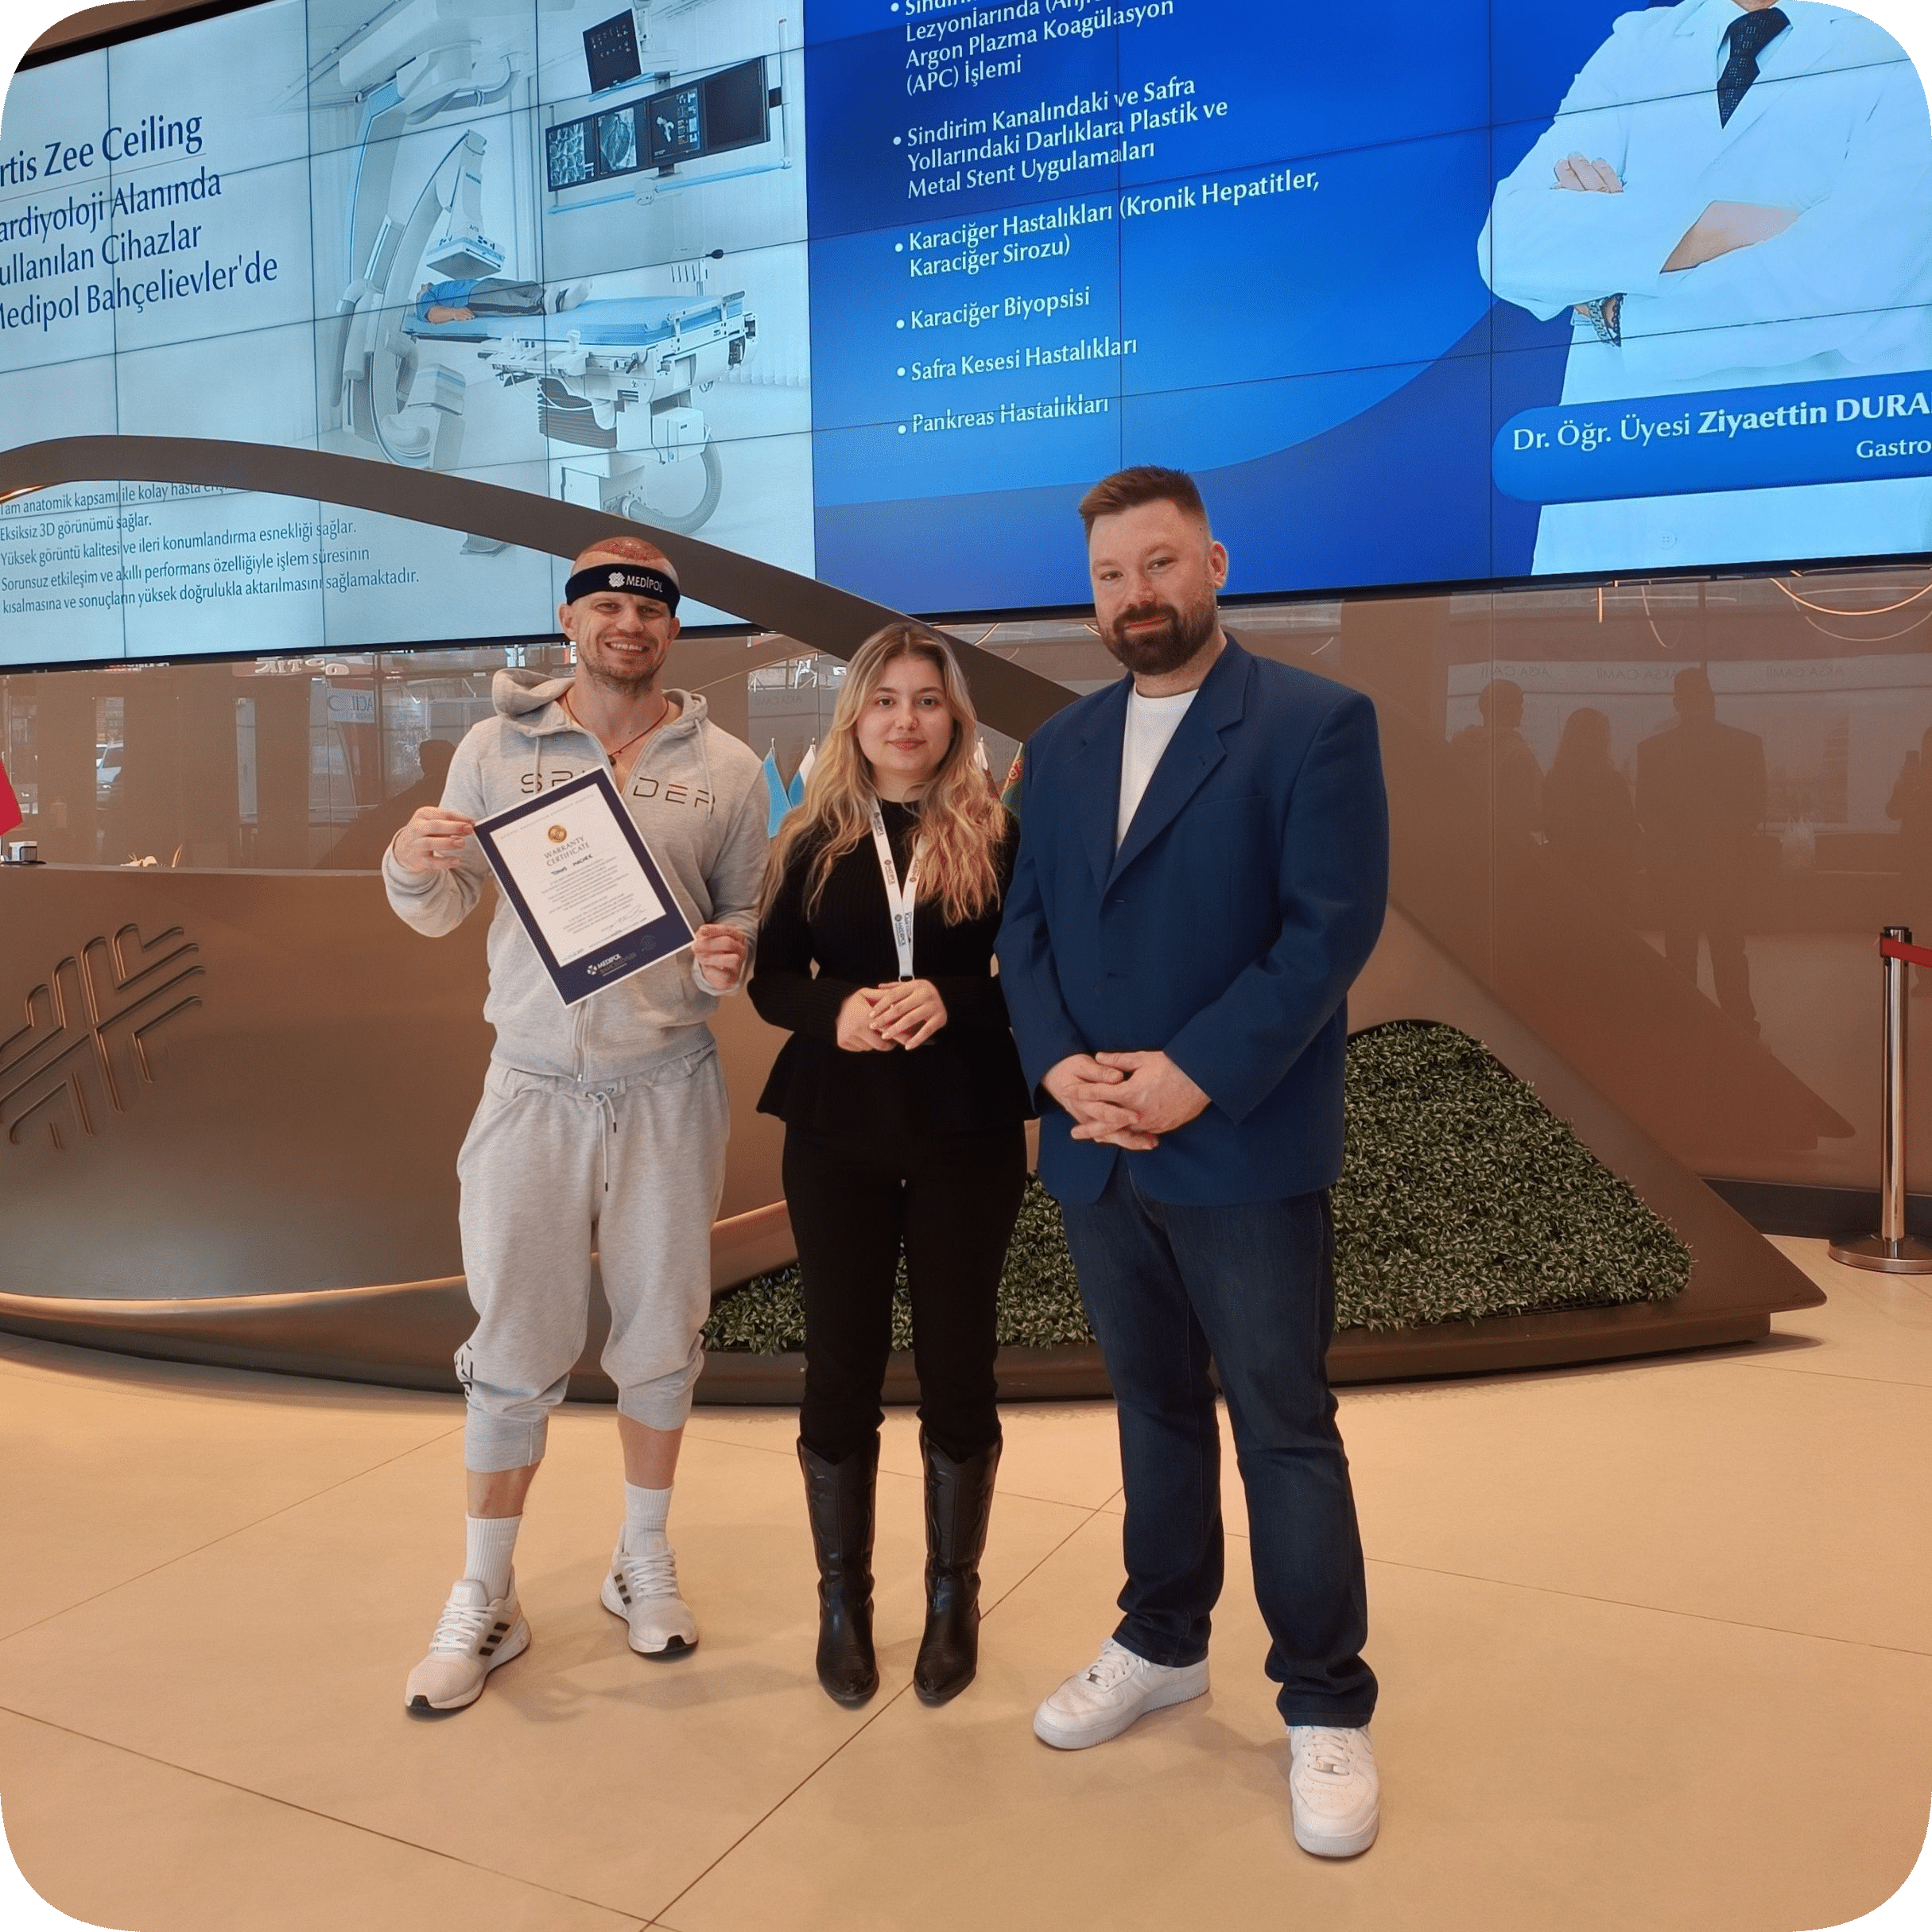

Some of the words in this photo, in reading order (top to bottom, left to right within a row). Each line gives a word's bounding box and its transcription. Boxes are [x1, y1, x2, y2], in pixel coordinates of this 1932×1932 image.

[906, 0, 1040, 42] Lezyonlarında
[906, 43, 963, 70] Argon
[969, 29, 1038, 56] Plazma
[1044, 0, 1174, 40] Koagülasyon
[906, 65, 959, 95] (APC)
[964, 54, 1022, 86] İşlemi
[907, 118, 987, 148] Sindirim
[992, 91, 1109, 131] Kanalındaki
[1115, 93, 1139, 107] ve
[1143, 76, 1196, 103] Safra
[44, 142, 94, 177] Zee
[102, 114, 202, 161] Ceiling
[908, 140, 1020, 173] Yollarındaki
[1026, 118, 1124, 152] Darlıklara
[1131, 103, 1199, 134] Plastik
[1203, 102, 1228, 118] ve
[111, 166, 222, 217] Alanında
[907, 174, 961, 200] Metal
[967, 165, 1015, 189] Stent
[1021, 143, 1155, 181] Uygulamaları
[909, 222, 998, 252] Karaciğer
[1003, 201, 1112, 236] Hastalıkları
[1119, 180, 1196, 220] (Kronik
[1201, 169, 1320, 206] Hepatitler,
[102, 220, 201, 264] Cihazlar
[910, 247, 999, 277] Karaciğer
[1003, 233, 1070, 262] Sirozu)
[0, 285, 79, 332] edipol
[87, 250, 277, 313] Bahçelievler'de
[911, 301, 999, 329] Karaciğer
[1004, 286, 1090, 320] Biyopsisi
[911, 358, 956, 381] Safra
[961, 350, 1019, 374] Kesesi
[1026, 336, 1137, 367] Hastalıkları
[913, 409, 994, 433] Pankreas
[1000, 394, 1108, 423] Hastalıkları
[1514, 429, 1549, 451] Dr.
[1558, 421, 1612, 451] Öğr.
[1620, 413, 1690, 446] Üyesi
[1698, 402, 1827, 438] Ziyaettin
[1837, 392, 1932, 420] DURA
[1856, 440, 1932, 458] Gastro
[23, 494, 72, 513] anatomik
[74, 492, 118, 510] kapsamı
[122, 487, 135, 502] ile
[138, 483, 168, 502] kolay
[0, 526, 37, 541] Eksiksiz
[40, 522, 55, 537] 3D
[58, 516, 114, 540] görünümü
[116, 512, 152, 533] sağlar.
[0, 549, 37, 566] Yüksek
[40, 545, 80, 567] görüntü
[83, 541, 119, 558] kalitesi
[122, 543, 136, 554] ve
[139, 537, 160, 552] ileri
[163, 529, 256, 550] konumlandırma
[259, 522, 312, 543] esnekliği
[316, 518, 356, 540] sağlar.
[2, 577, 48, 591] Sorunsuz
[51, 570, 98, 588] etkileşim
[100, 572, 113, 583] ve
[116, 564, 142, 581] akıllı
[145, 561, 210, 584] performans
[213, 553, 274, 575] özelliğiyle
[277, 550, 308, 572] işlem
[312, 546, 370, 564] süresinin
[3, 598, 61, 614] kısalmasına
[64, 598, 76, 609] ve
[79, 591, 135, 610] sonuçların
[138, 586, 177, 608] yüksek
[180, 580, 242, 604] doğrulukla
[246, 576, 322, 596] aktarılmasını
[326, 567, 419, 593] sağlamaktadır.
[544, 836, 584, 859] WARRANTY
[547, 842, 590, 867] CERTIFICATE
